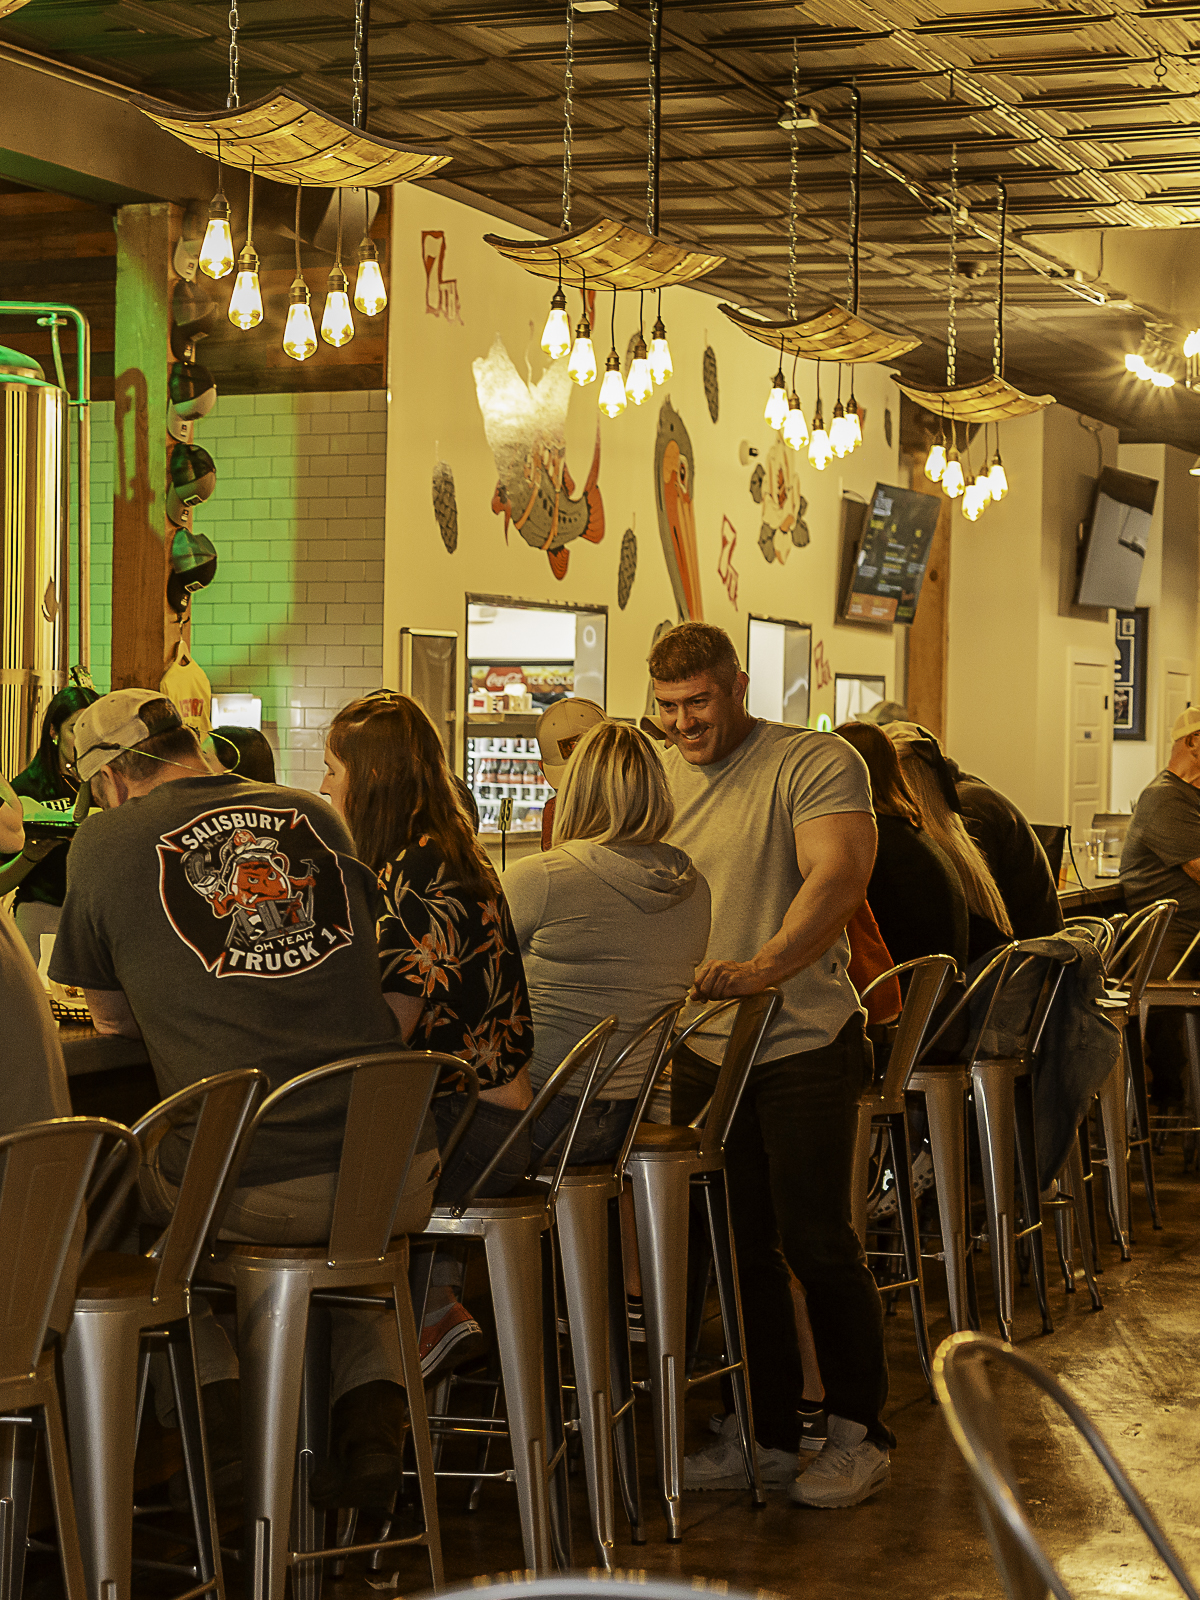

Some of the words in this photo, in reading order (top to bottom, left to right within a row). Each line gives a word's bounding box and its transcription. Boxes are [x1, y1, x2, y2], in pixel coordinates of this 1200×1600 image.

[527, 676, 545, 685] ICE
[40, 797, 72, 811] THE
[181, 812, 286, 850] SALISBURY
[202, 834, 229, 850] N.C.
[229, 940, 320, 971] TRUCK
[321, 927, 337, 945] 1
[254, 941, 274, 953] OH
[277, 931, 314, 947] YEAH
